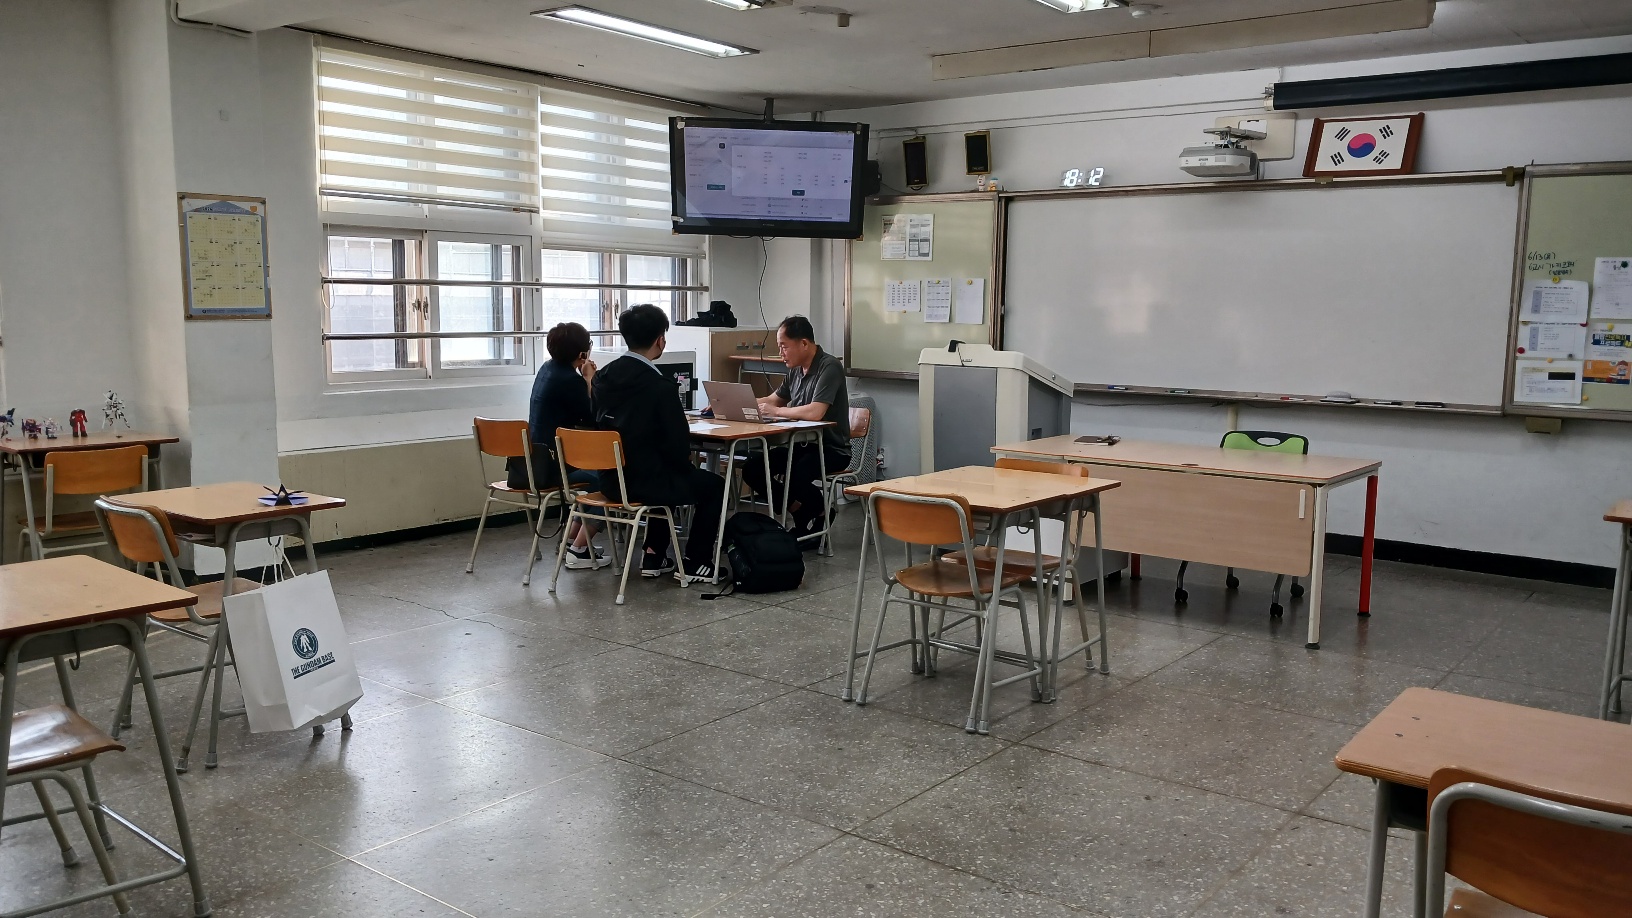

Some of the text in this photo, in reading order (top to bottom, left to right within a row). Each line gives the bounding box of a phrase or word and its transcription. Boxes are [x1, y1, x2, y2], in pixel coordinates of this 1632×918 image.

[291, 666, 300, 676] THE
[301, 657, 322, 672] GUNDAM
[321, 652, 334, 663] BASE
